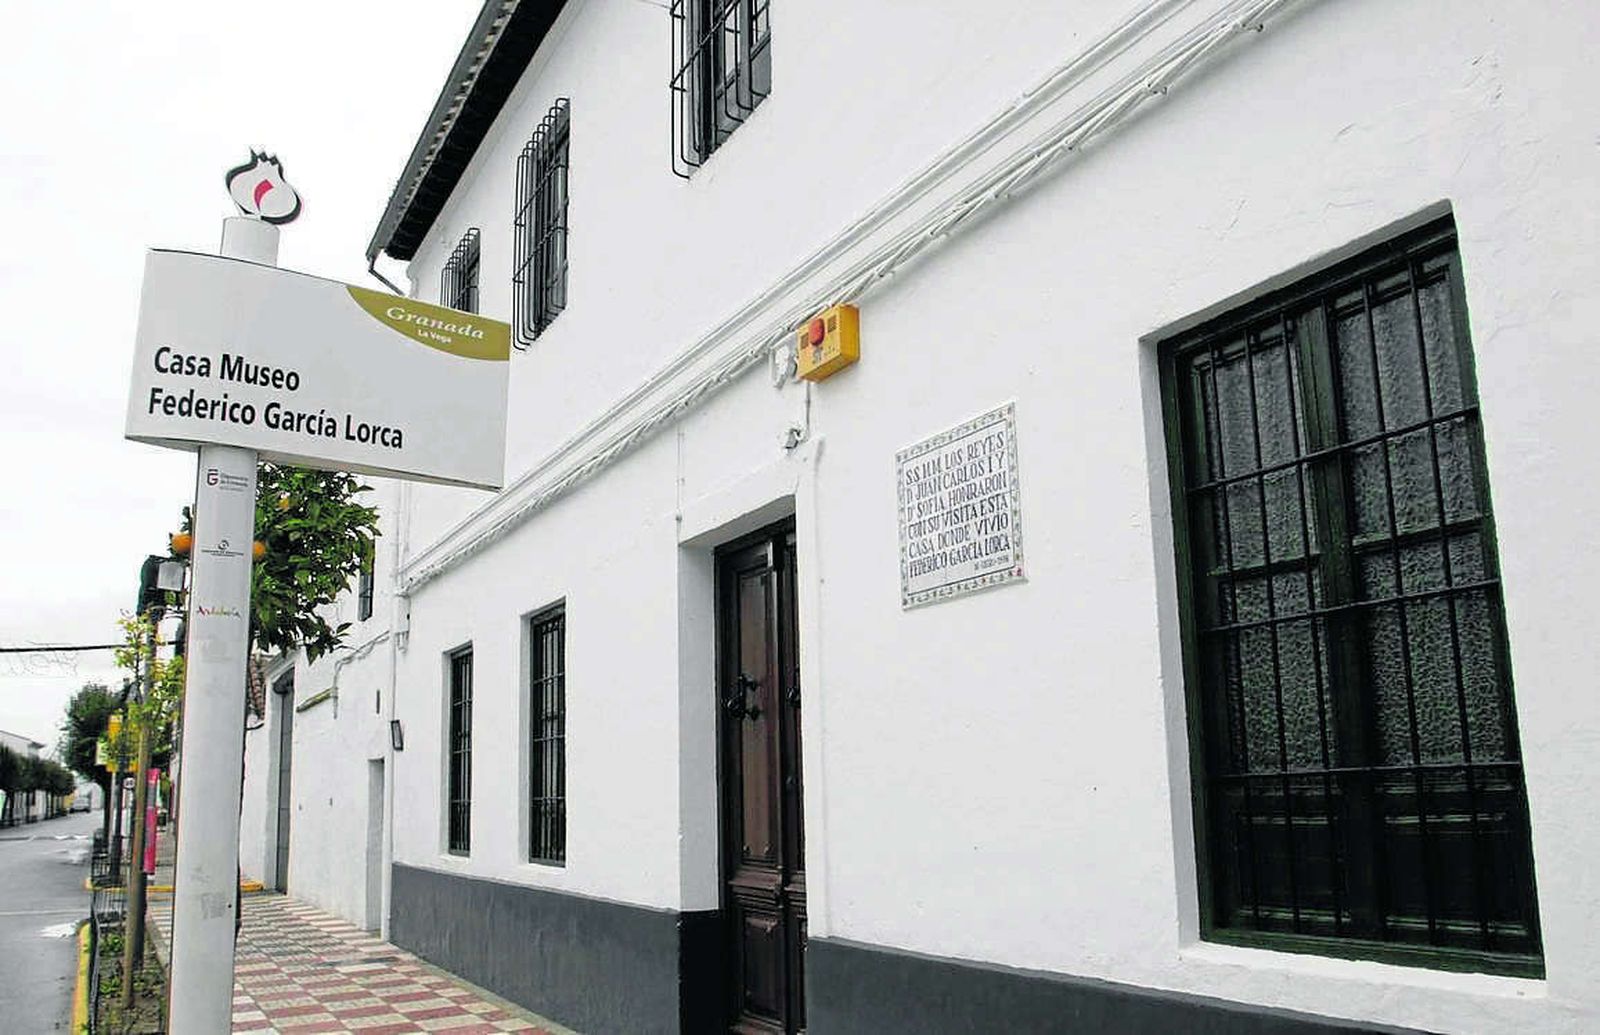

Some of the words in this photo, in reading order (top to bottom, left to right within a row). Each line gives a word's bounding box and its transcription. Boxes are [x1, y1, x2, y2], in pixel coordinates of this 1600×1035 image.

[386, 306, 485, 339] Granada
[418, 328, 429, 337] La
[430, 331, 452, 344] Vega
[154, 346, 211, 378] Casa
[219, 353, 300, 391] Museo
[148, 387, 256, 425] Federico
[263, 402, 337, 438] García
[345, 414, 403, 449] Lorca
[945, 447, 963, 470] LOS
[967, 431, 1004, 462] REYES
[915, 475, 942, 501] JUAN
[943, 459, 985, 490] CARLOS
[995, 451, 1005, 469] Y
[917, 494, 945, 519] SOFIA
[948, 470, 1007, 508] HONRARON
[908, 519, 926, 540] CON
[927, 514, 941, 534] SU
[942, 503, 978, 527] VISITA
[980, 493, 1008, 517] ESTA
[909, 538, 934, 559] CASA
[938, 522, 970, 550] DONDE
[909, 550, 948, 578] FEDERICO
[984, 532, 1010, 556] LORCA
